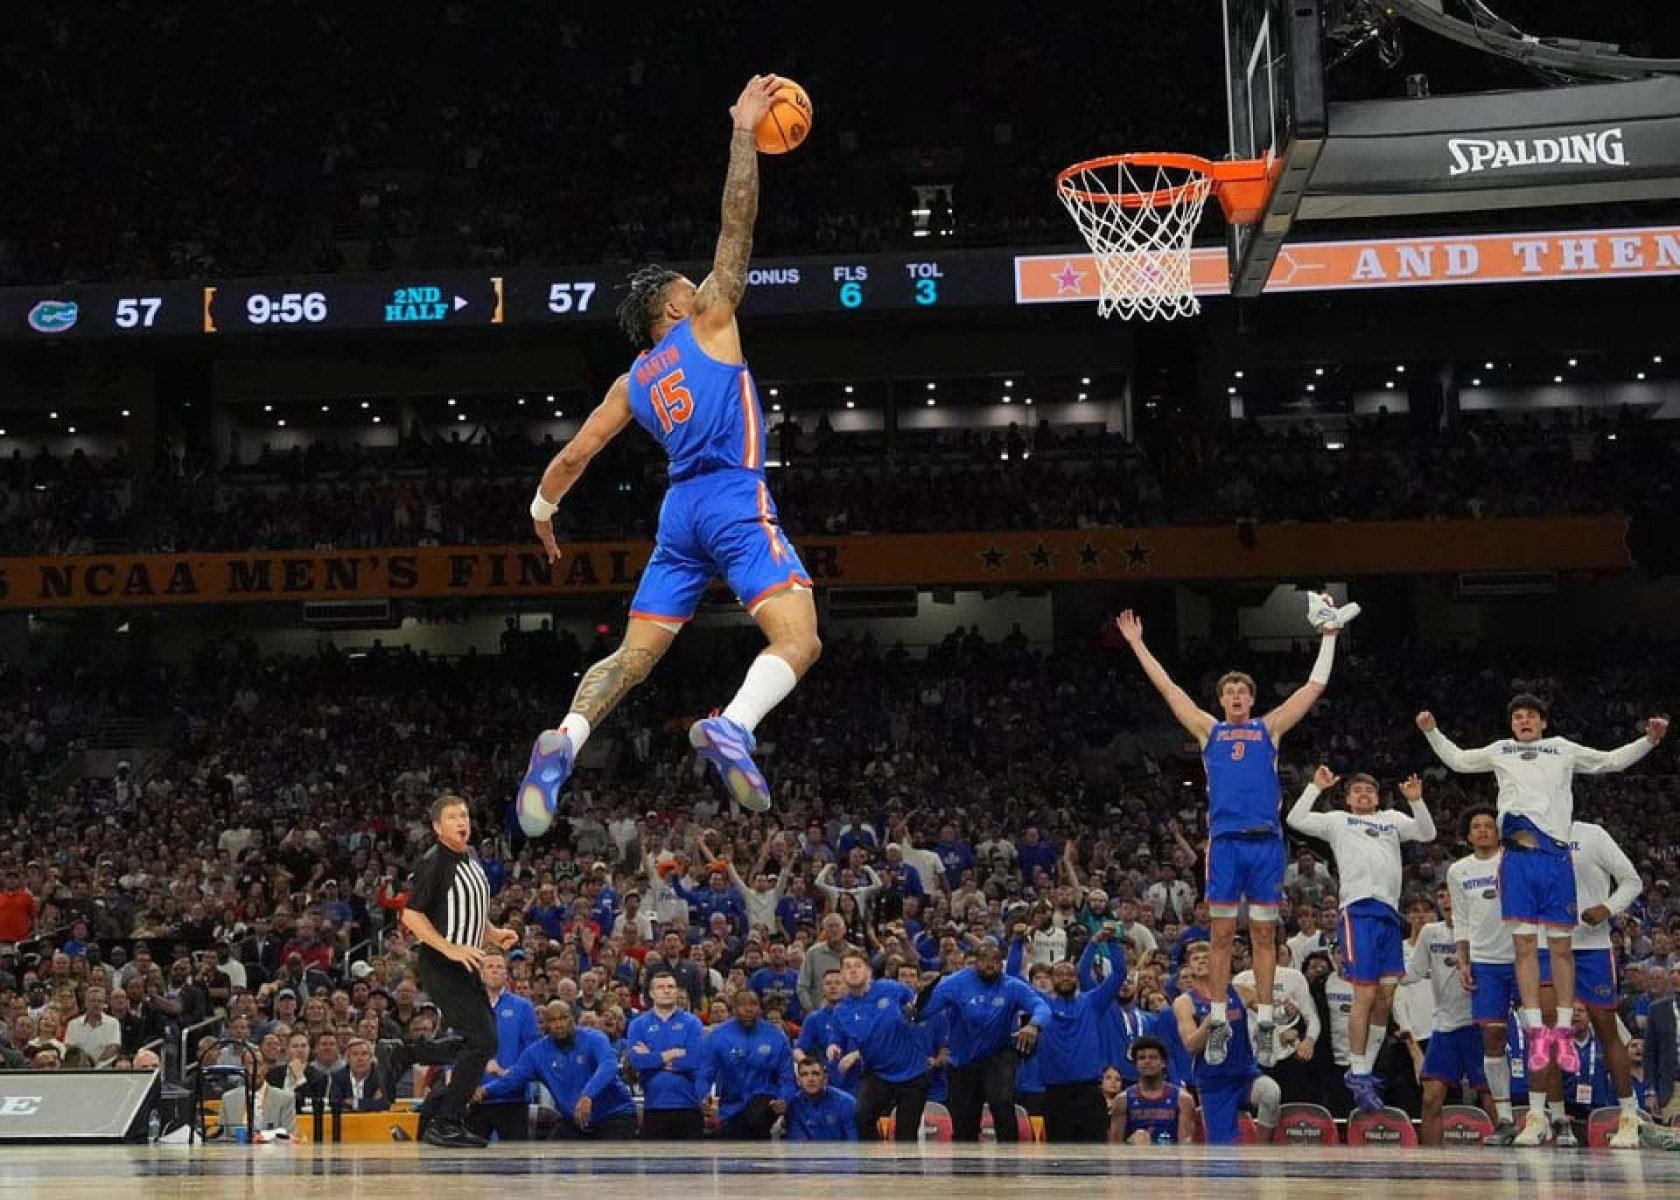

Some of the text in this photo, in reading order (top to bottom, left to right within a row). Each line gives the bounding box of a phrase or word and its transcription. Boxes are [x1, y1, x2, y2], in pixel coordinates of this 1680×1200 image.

[1448, 127, 1625, 176] SPALDING
[1352, 232, 1680, 281] AND THEN
[746, 268, 800, 286] ONUS
[833, 265, 868, 281] FLS
[905, 262, 943, 279] TOL
[393, 286, 441, 304] 2ND
[548, 281, 596, 314] 57
[840, 282, 863, 309] 6
[914, 279, 938, 306] 3
[115, 298, 162, 328] 57
[247, 292, 328, 324] 9:56
[384, 303, 449, 322] HALF
[651, 369, 694, 434] 15
[40, 561, 200, 597] NCAA
[227, 555, 419, 593] MEN'S
[448, 551, 642, 588] FINAL
[1231, 741, 1245, 761] 3
